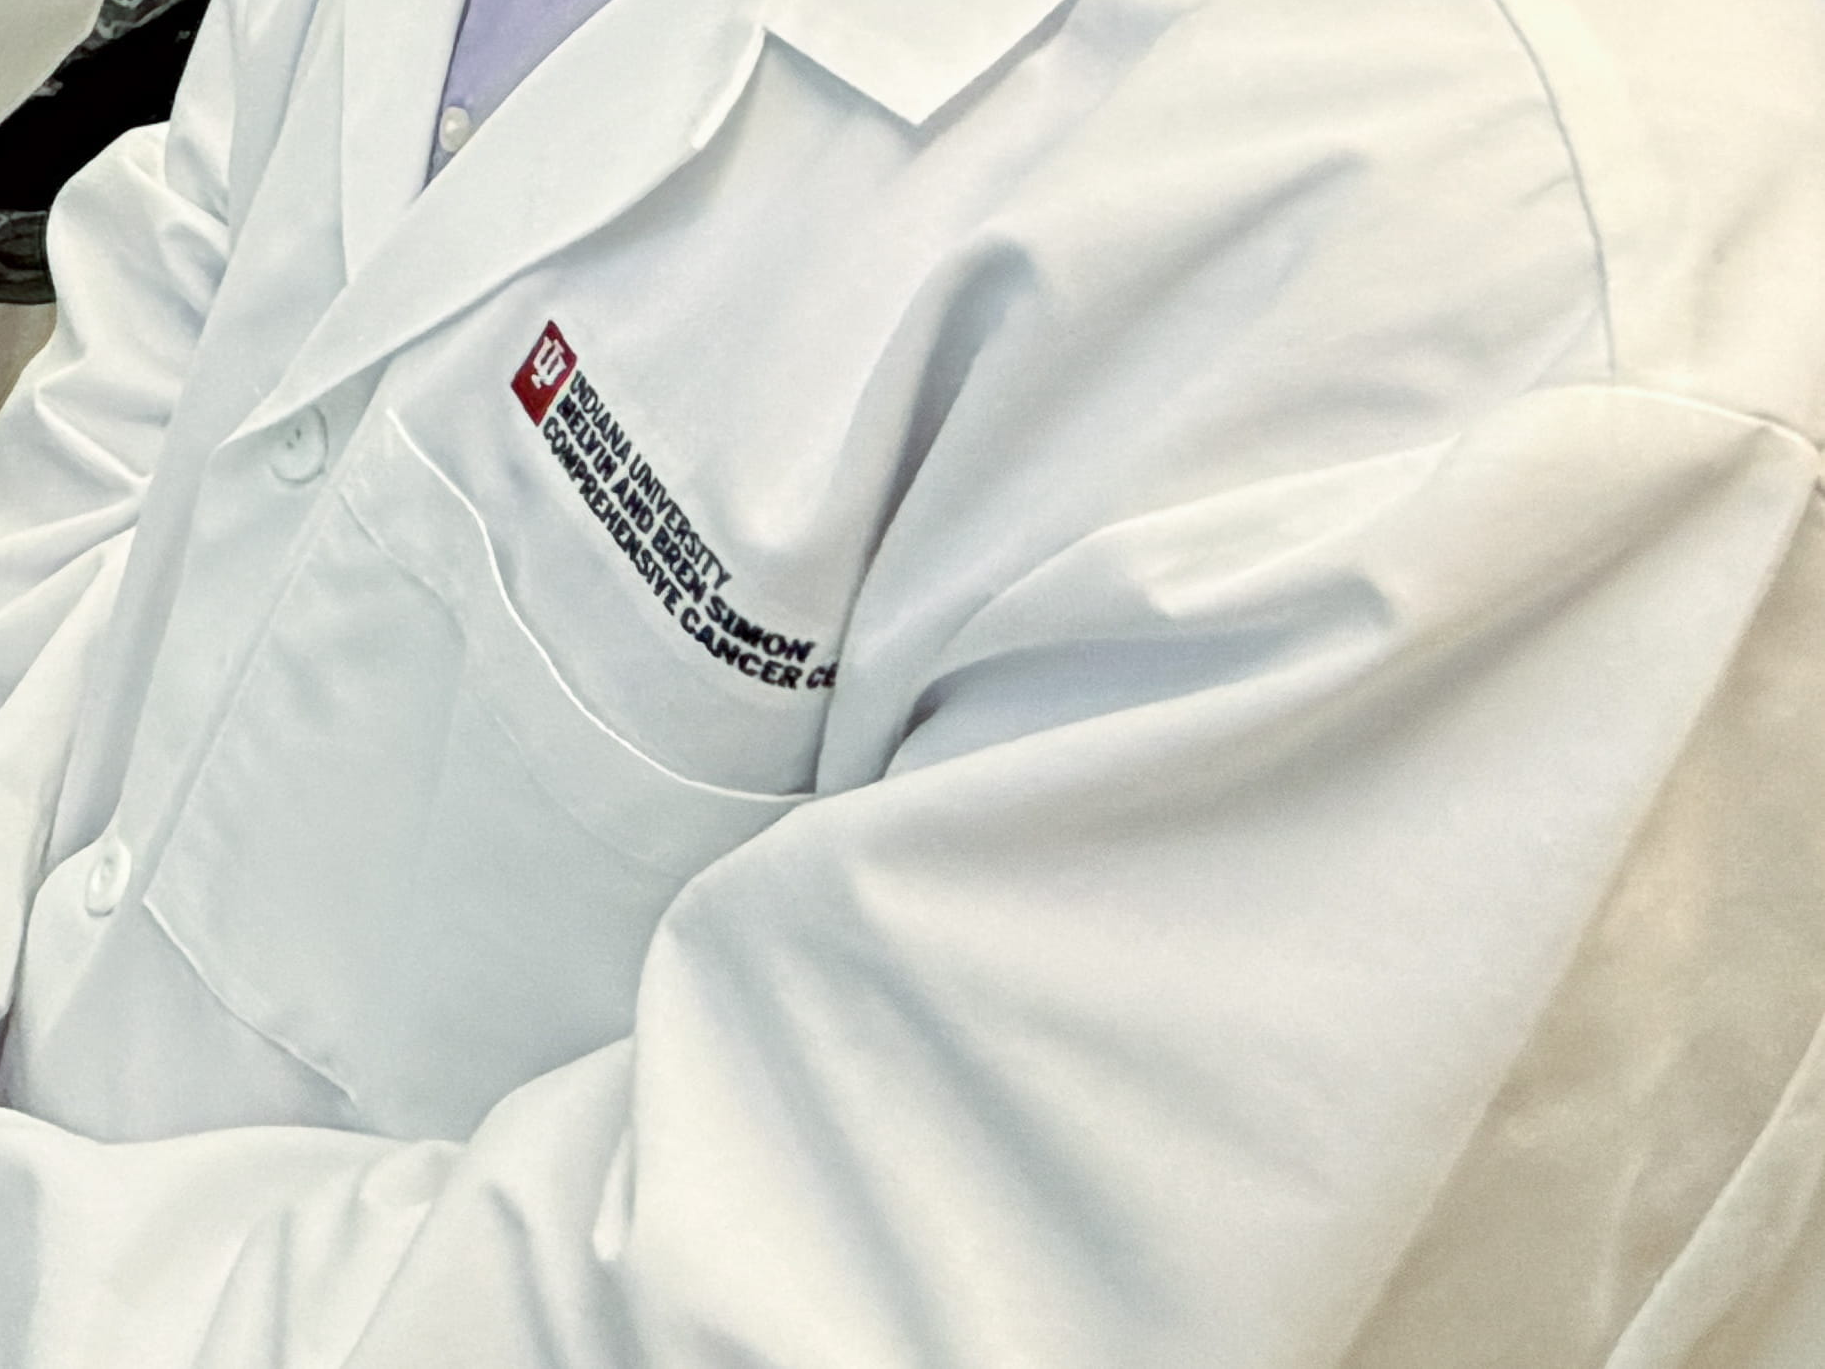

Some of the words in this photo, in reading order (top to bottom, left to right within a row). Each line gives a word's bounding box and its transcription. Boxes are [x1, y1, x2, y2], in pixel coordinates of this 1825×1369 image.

[542, 416, 684, 616] COMPREHENSIVE
[679, 606, 805, 690] CANCER
[556, 393, 620, 484] MELVIN
[611, 476, 656, 535] AND
[651, 527, 708, 605] BREN
[704, 594, 816, 664] SIMON
[569, 368, 633, 465] INDIANA
[628, 453, 733, 591] UNIVERSITY
